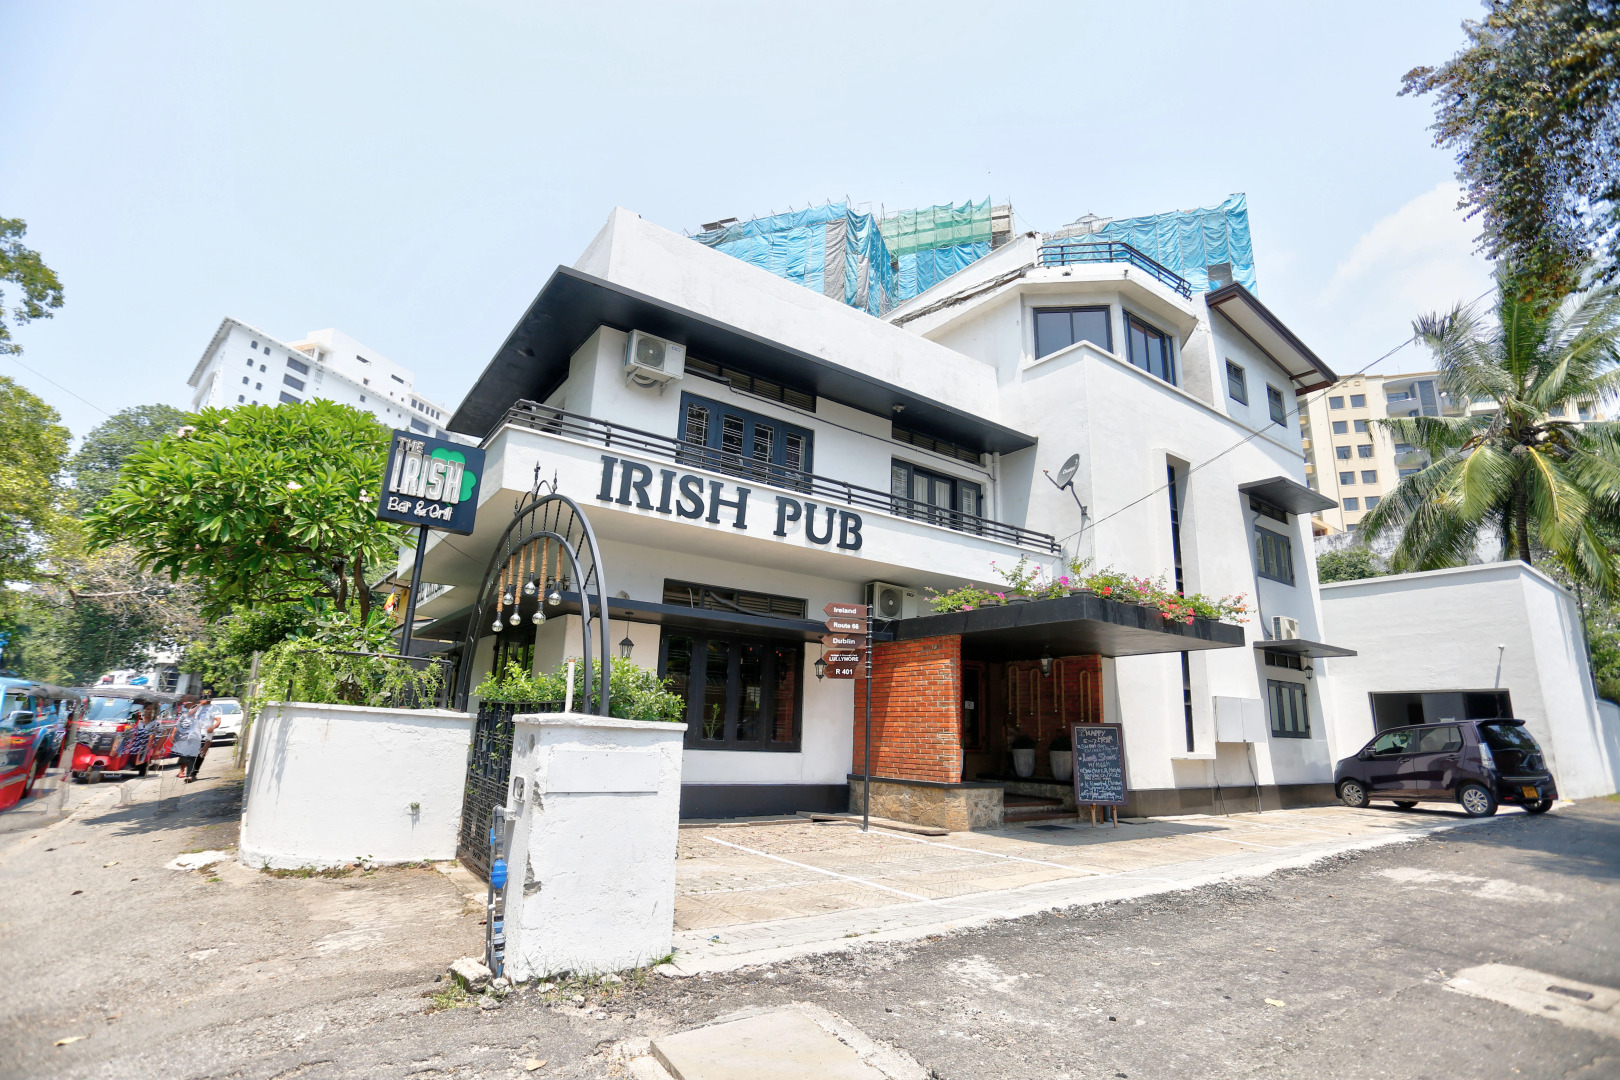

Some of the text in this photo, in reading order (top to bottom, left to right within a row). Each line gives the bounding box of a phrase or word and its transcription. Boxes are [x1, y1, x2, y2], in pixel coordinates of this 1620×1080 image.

[397, 436, 425, 453] THE
[388, 448, 465, 504] IRISH
[387, 496, 453, 521] Bar & Grill
[596, 455, 863, 550] IRISH PUB
[833, 606, 857, 614] Ireland
[1085, 729, 1106, 737] HAPPY
